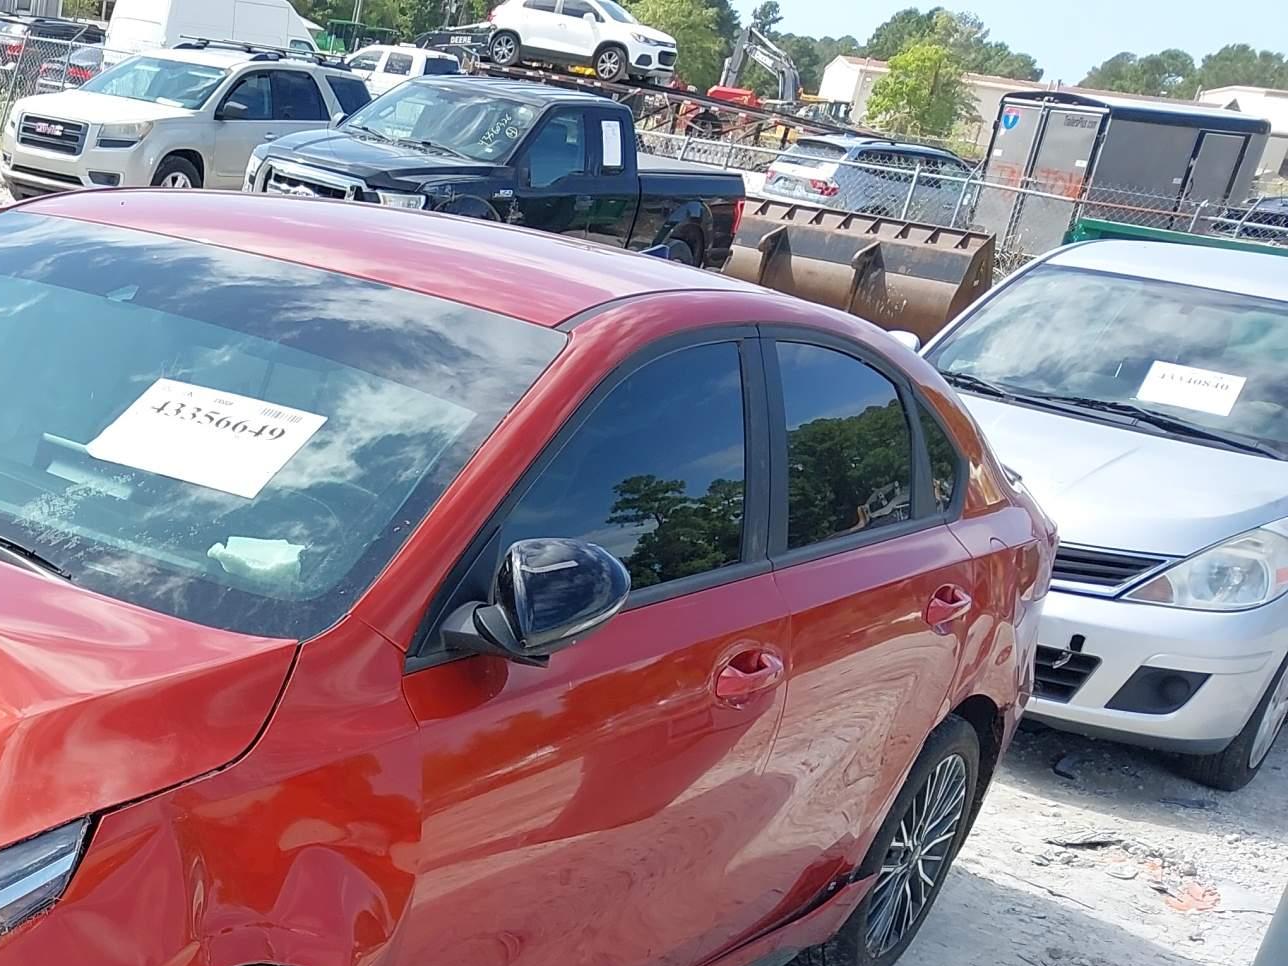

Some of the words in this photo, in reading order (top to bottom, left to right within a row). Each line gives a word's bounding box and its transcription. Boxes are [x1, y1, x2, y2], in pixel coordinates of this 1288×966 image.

[450, 35, 472, 44] DEERE
[35, 121, 64, 136] GMC
[151, 400, 286, 440] 43356649
